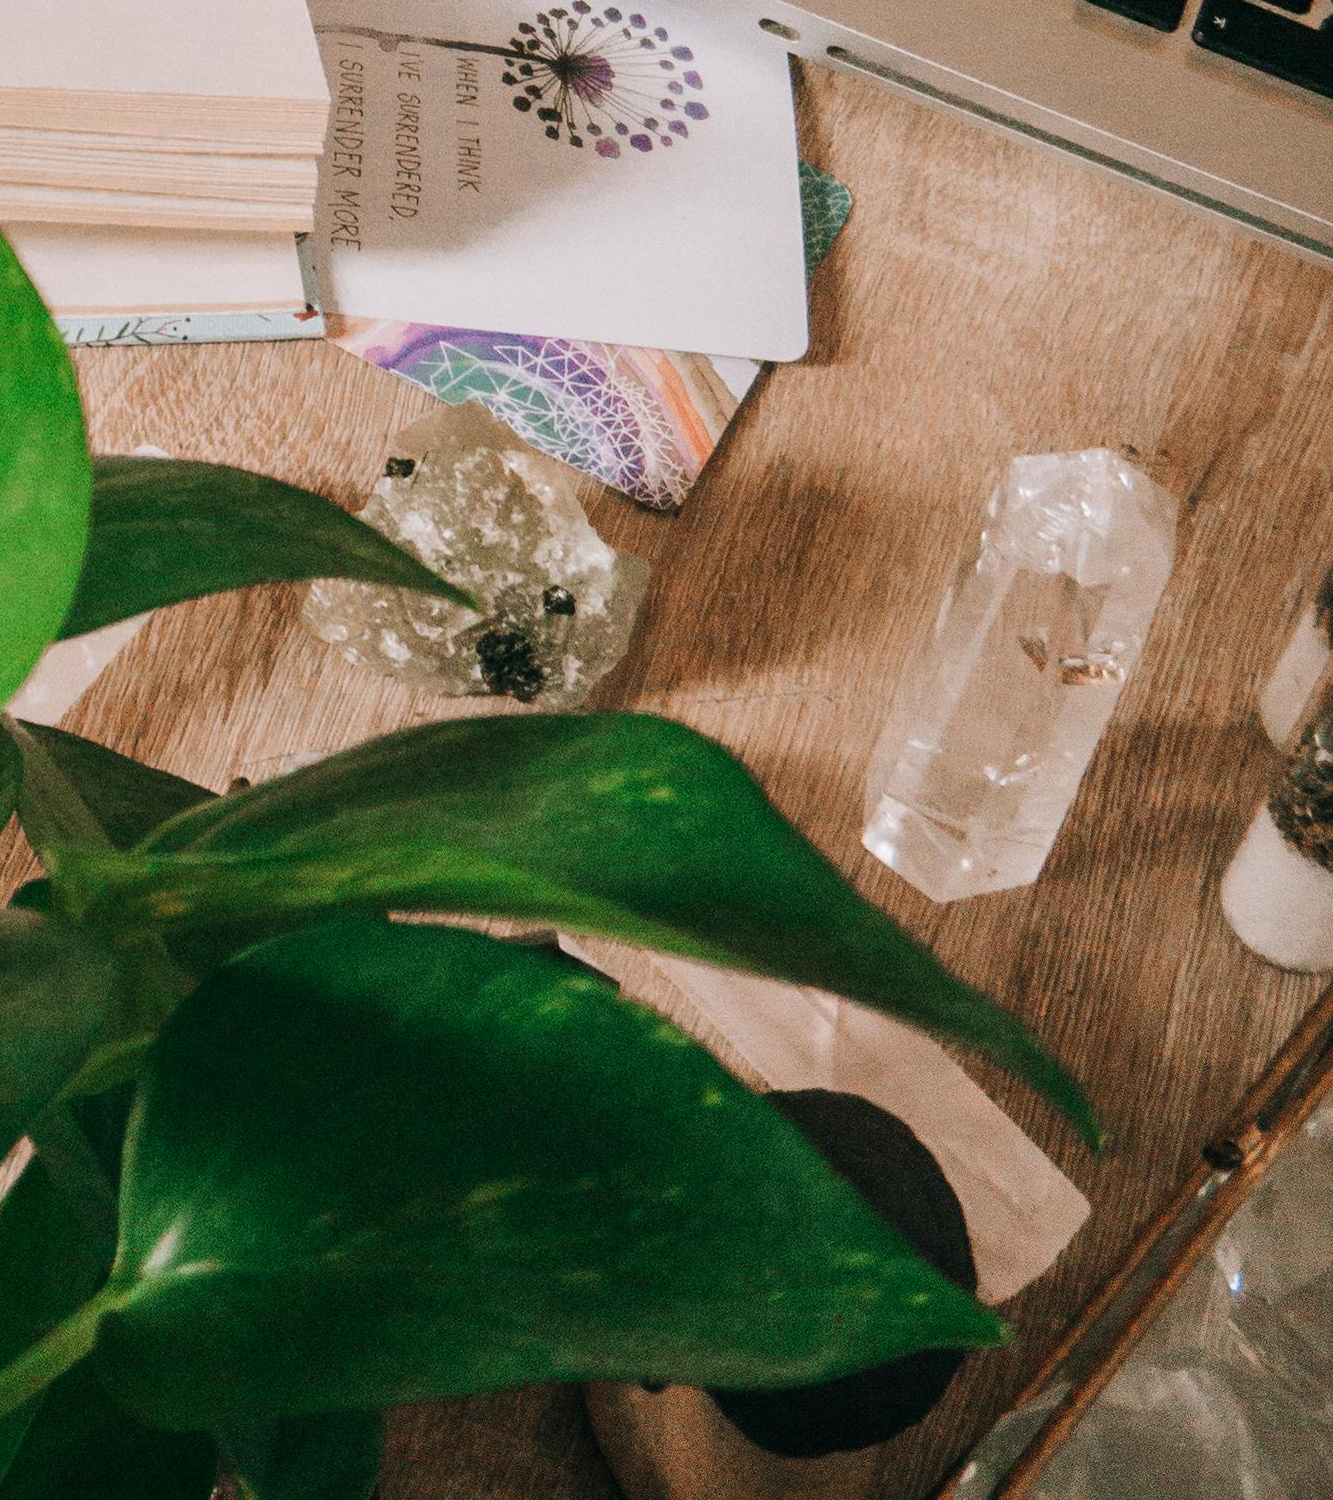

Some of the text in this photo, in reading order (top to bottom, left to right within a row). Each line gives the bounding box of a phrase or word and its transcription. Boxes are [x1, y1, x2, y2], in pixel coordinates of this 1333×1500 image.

[337, 41, 364, 50] I
[332, 58, 365, 179] SURRENDER
[388, 51, 425, 221] I'VE SURRENDERED,
[455, 56, 483, 194] WHEN I THINK
